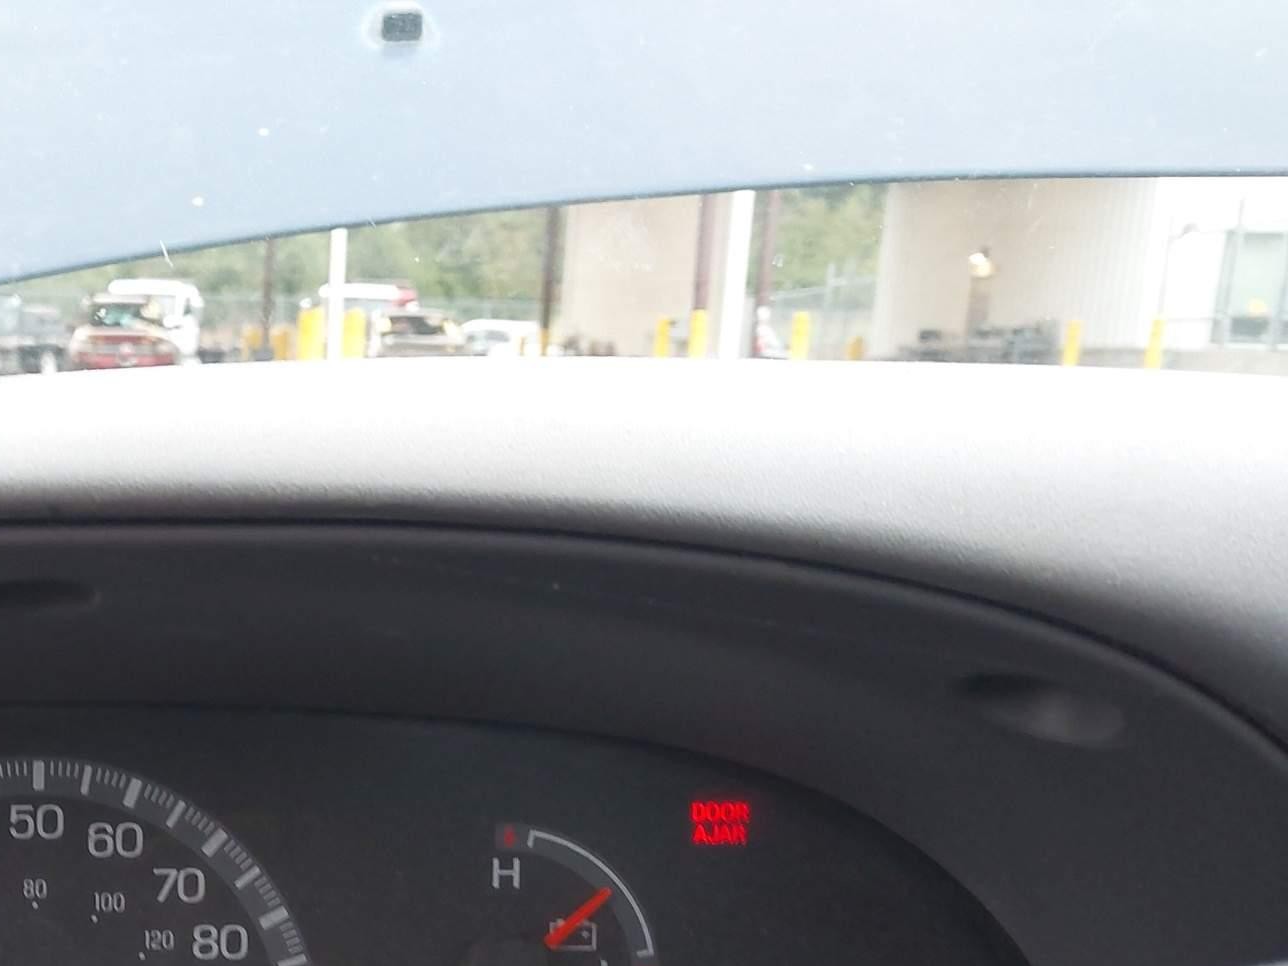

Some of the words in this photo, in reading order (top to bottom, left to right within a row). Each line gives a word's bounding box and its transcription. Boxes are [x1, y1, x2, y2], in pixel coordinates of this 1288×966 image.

[9, 804, 64, 840] 50
[691, 800, 750, 822] DOOR
[87, 823, 143, 858] 60
[692, 823, 747, 845] AJAR
[153, 868, 206, 903] 70
[492, 857, 521, 890] H
[23, 879, 47, 899] 80
[94, 892, 125, 912] 100
[144, 930, 174, 950] 120
[192, 924, 248, 960] 80
